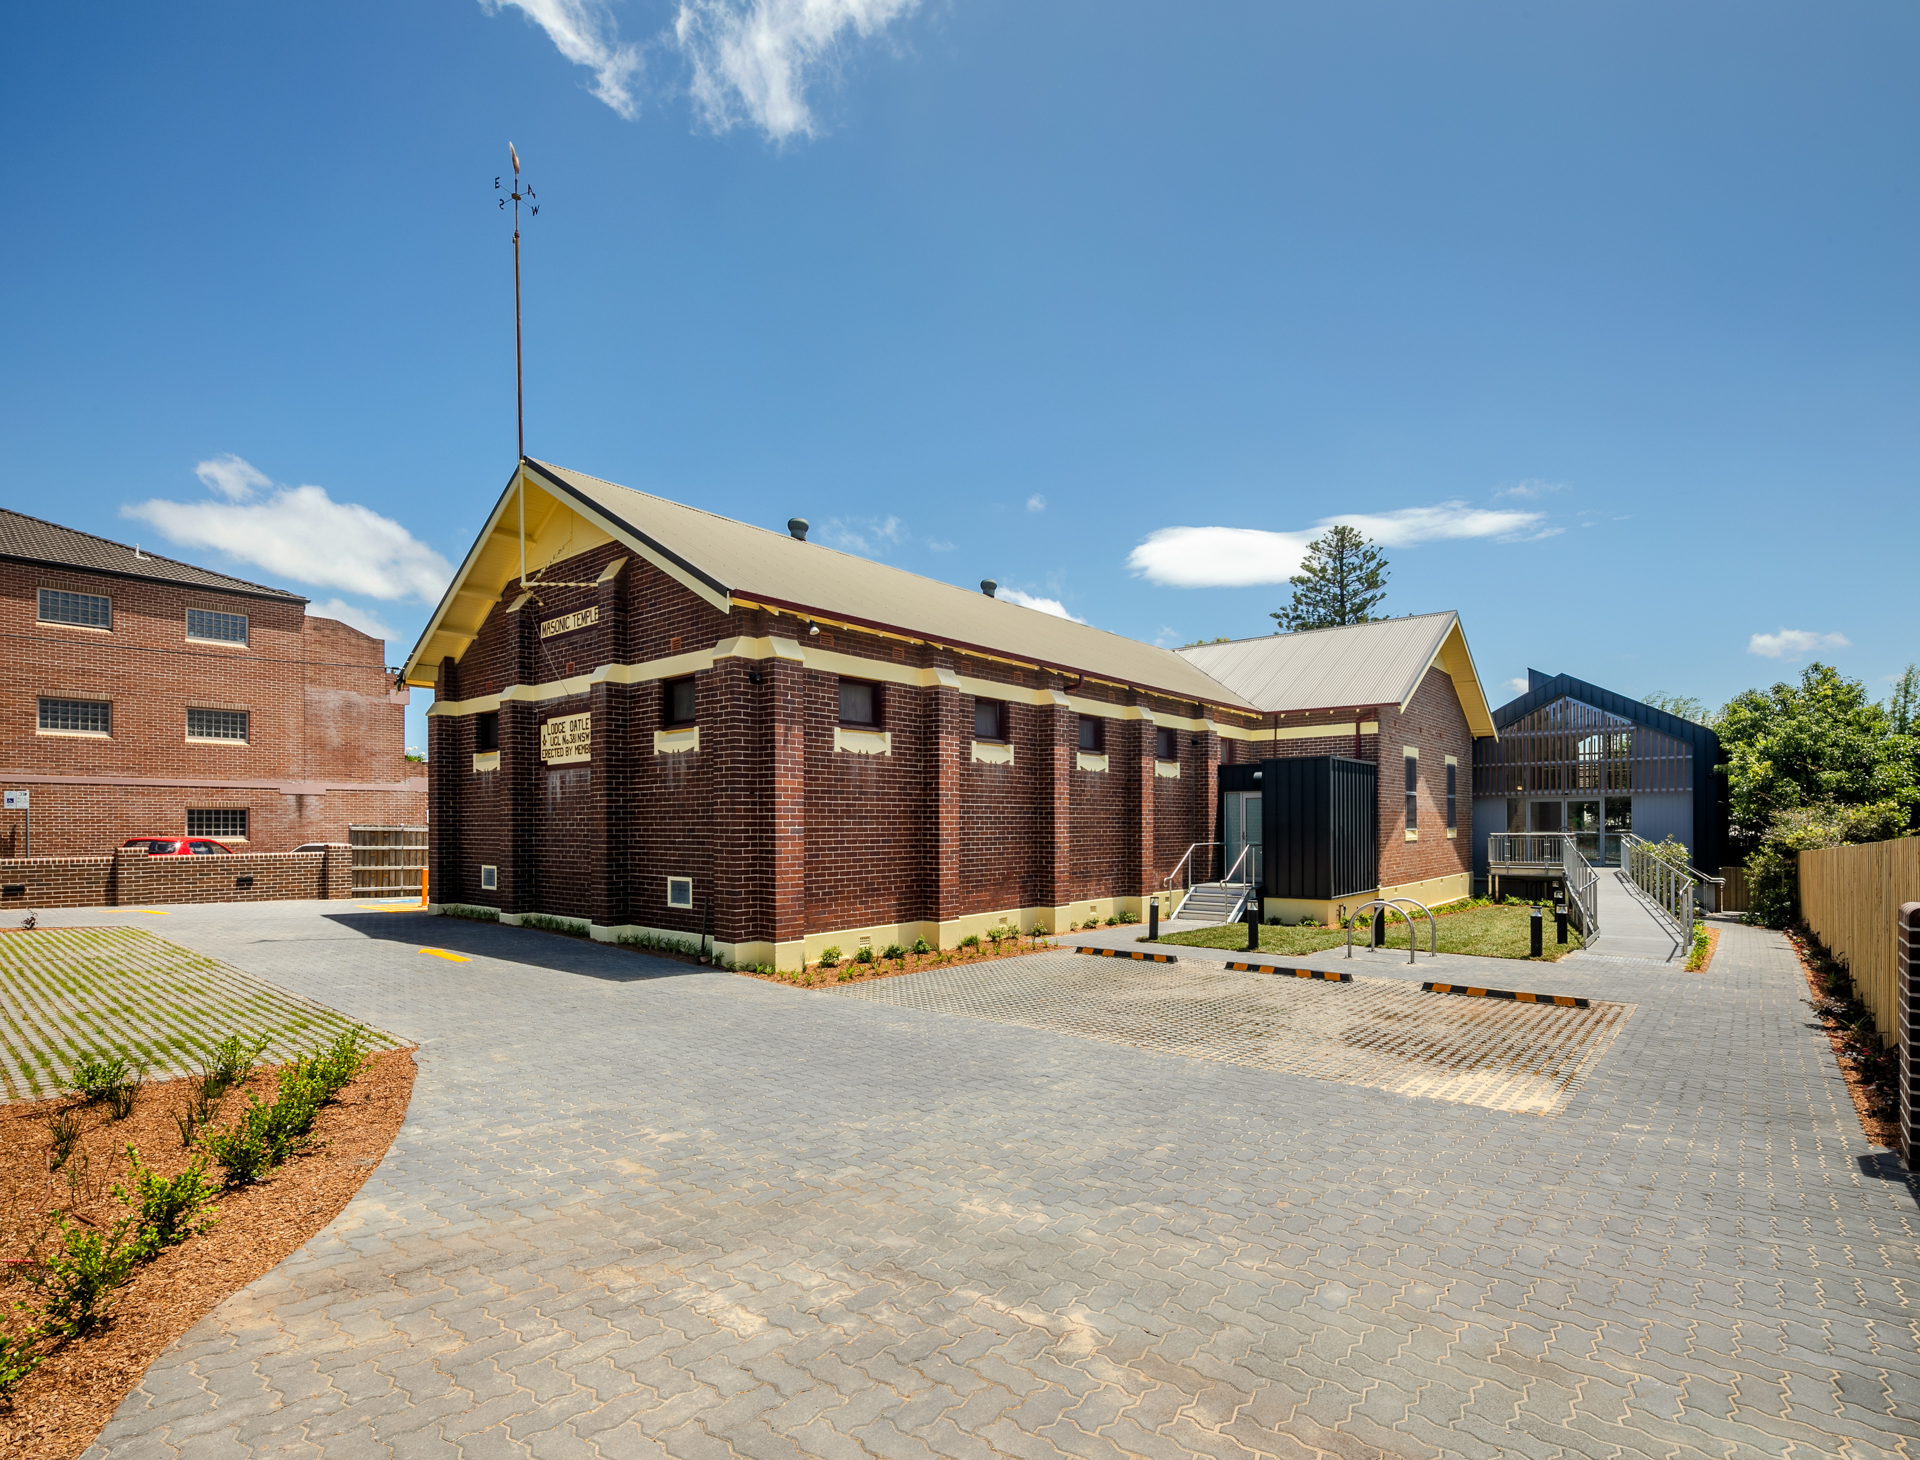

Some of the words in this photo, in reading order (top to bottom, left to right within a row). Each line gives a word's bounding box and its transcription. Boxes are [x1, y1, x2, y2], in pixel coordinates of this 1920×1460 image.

[542, 616, 570, 636] MASONIC
[572, 607, 598, 628] TEMPLE
[547, 721, 566, 736] LODGE
[542, 748, 564, 758] ERECTED
[566, 746, 573, 756] BY
